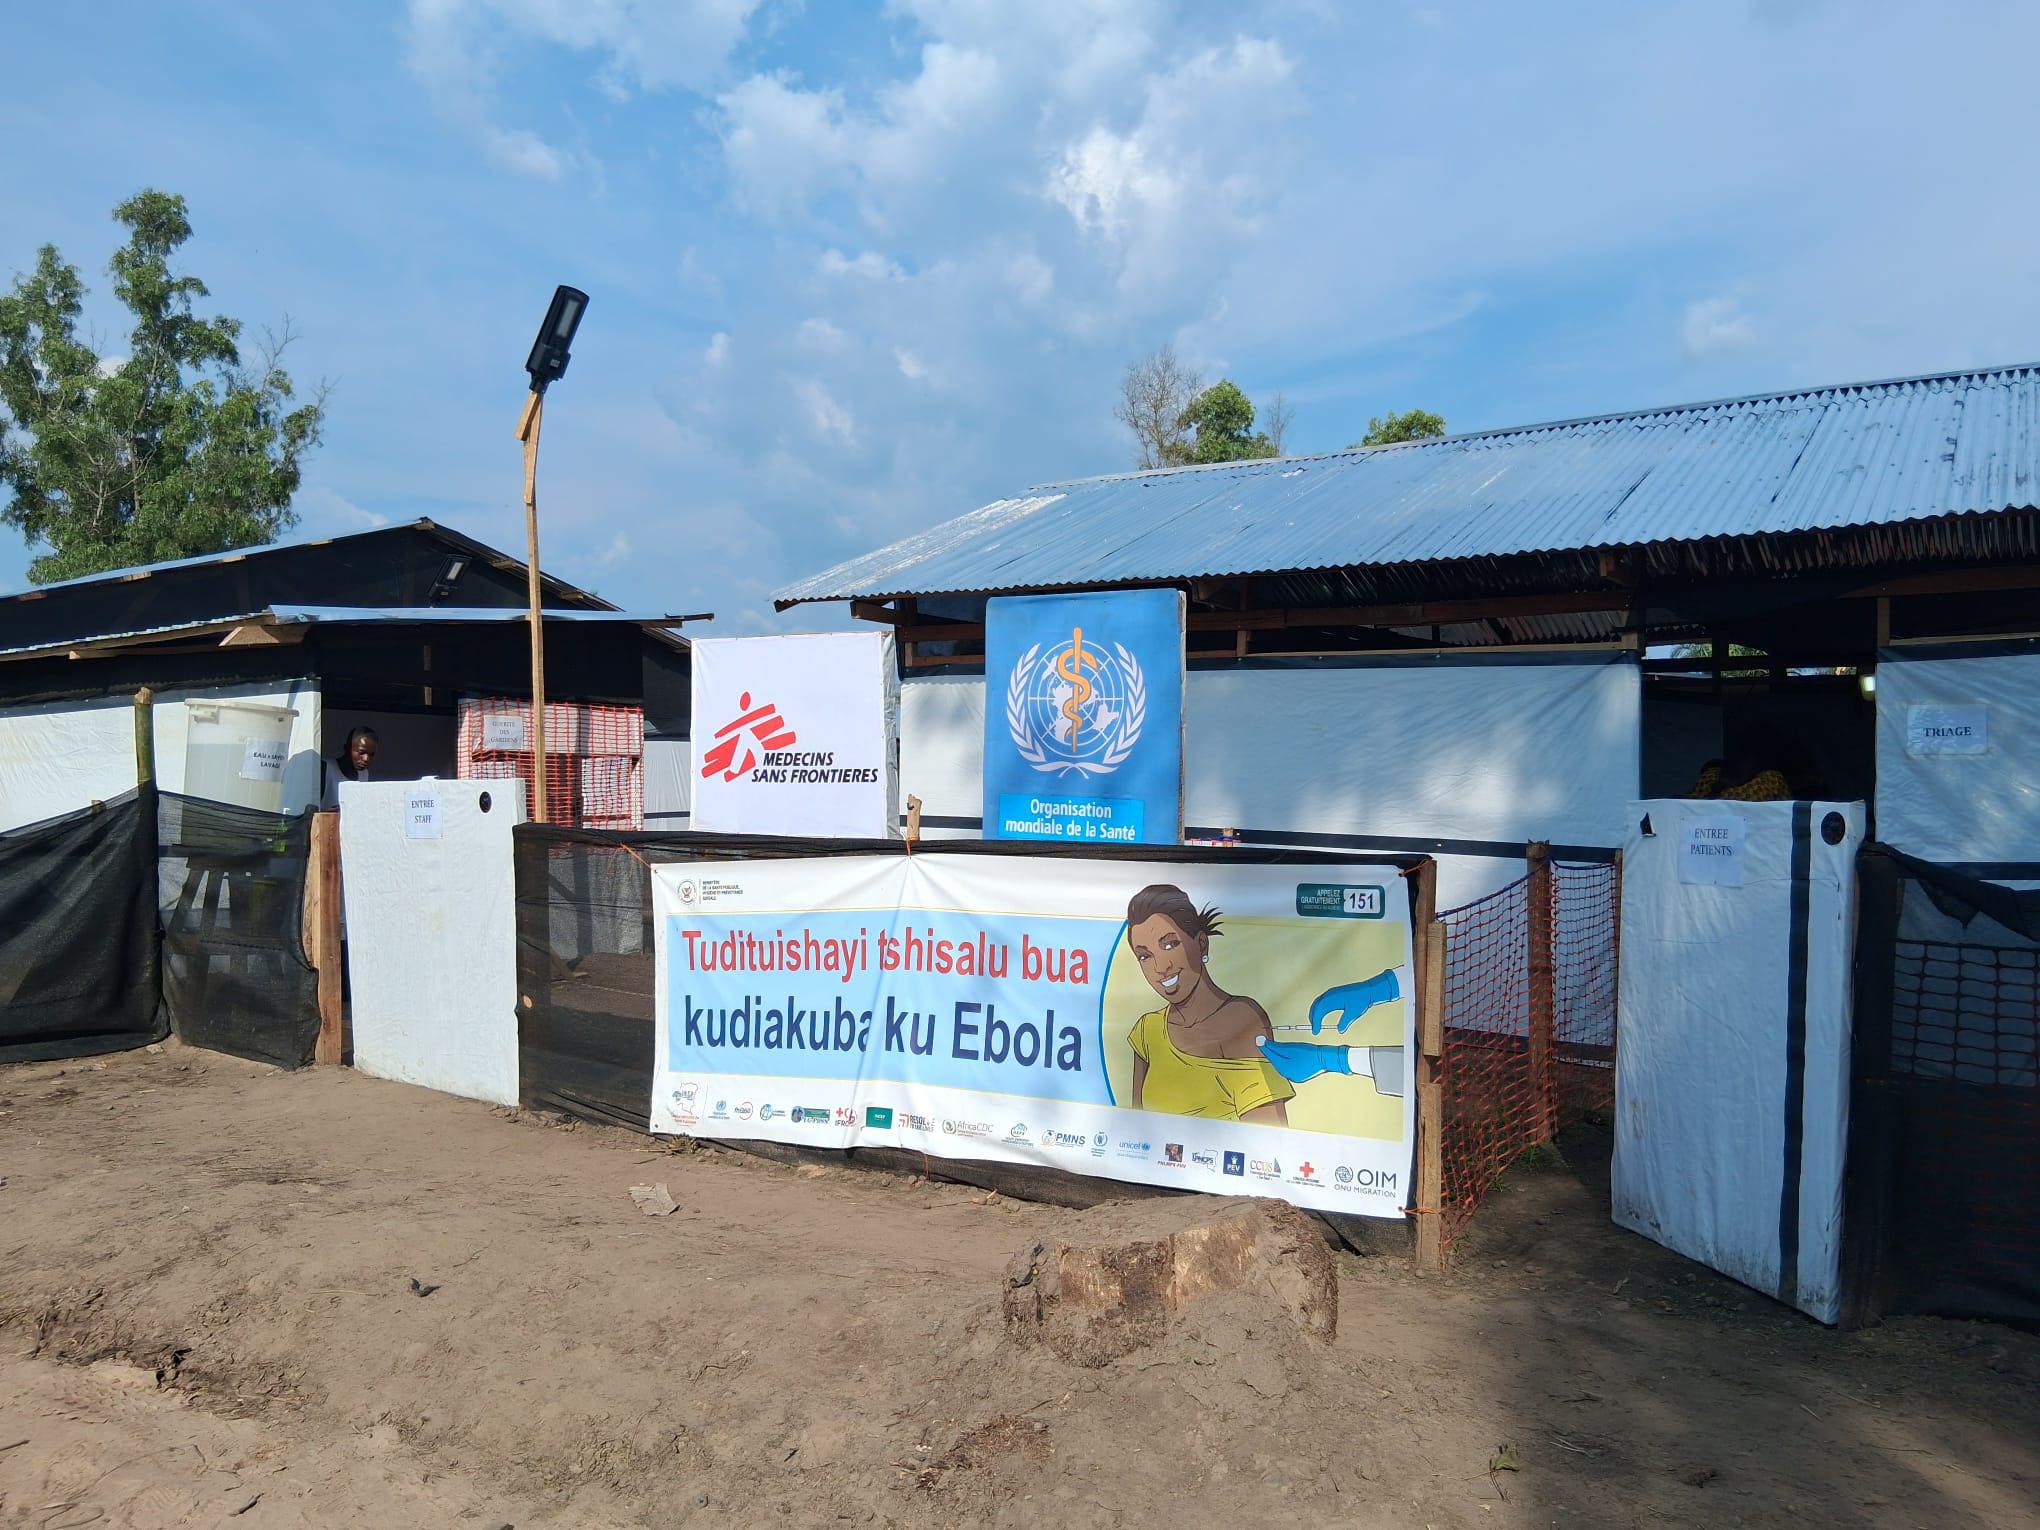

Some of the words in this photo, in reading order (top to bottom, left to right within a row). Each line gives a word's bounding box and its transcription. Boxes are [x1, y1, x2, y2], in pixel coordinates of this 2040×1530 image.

[1923, 726, 1972, 737] TRIAGE
[763, 752, 834, 767] MEDECINS
[751, 769, 788, 784] SANS
[790, 768, 879, 784] FRONTIERES
[1030, 798, 1112, 819] Organisation
[414, 814, 433, 824] STAFF
[1005, 818, 1063, 835] mondiale
[1066, 820, 1081, 836] de
[1085, 821, 1097, 837] la
[1099, 822, 1136, 841] Santé
[1690, 844, 1733, 856] PATIENTS
[1300, 896, 1341, 905] GRATUITEMENT
[1316, 889, 1341, 897] APPELEZ
[1349, 892, 1374, 910] 151
[682, 927, 867, 983] Tudituishayi
[878, 926, 1008, 979] tshisalu
[1022, 934, 1089, 985] bua
[685, 994, 873, 1053] kudiakuba
[884, 995, 936, 1056] ku
[951, 1001, 1083, 1072] Ebola
[1055, 1132, 1086, 1145] PMNS
[1226, 1163, 1241, 1172] PEV
[1357, 1168, 1397, 1190] OIM
[1334, 1183, 1352, 1192] ONU
[1353, 1186, 1396, 1198] MIGRATION
